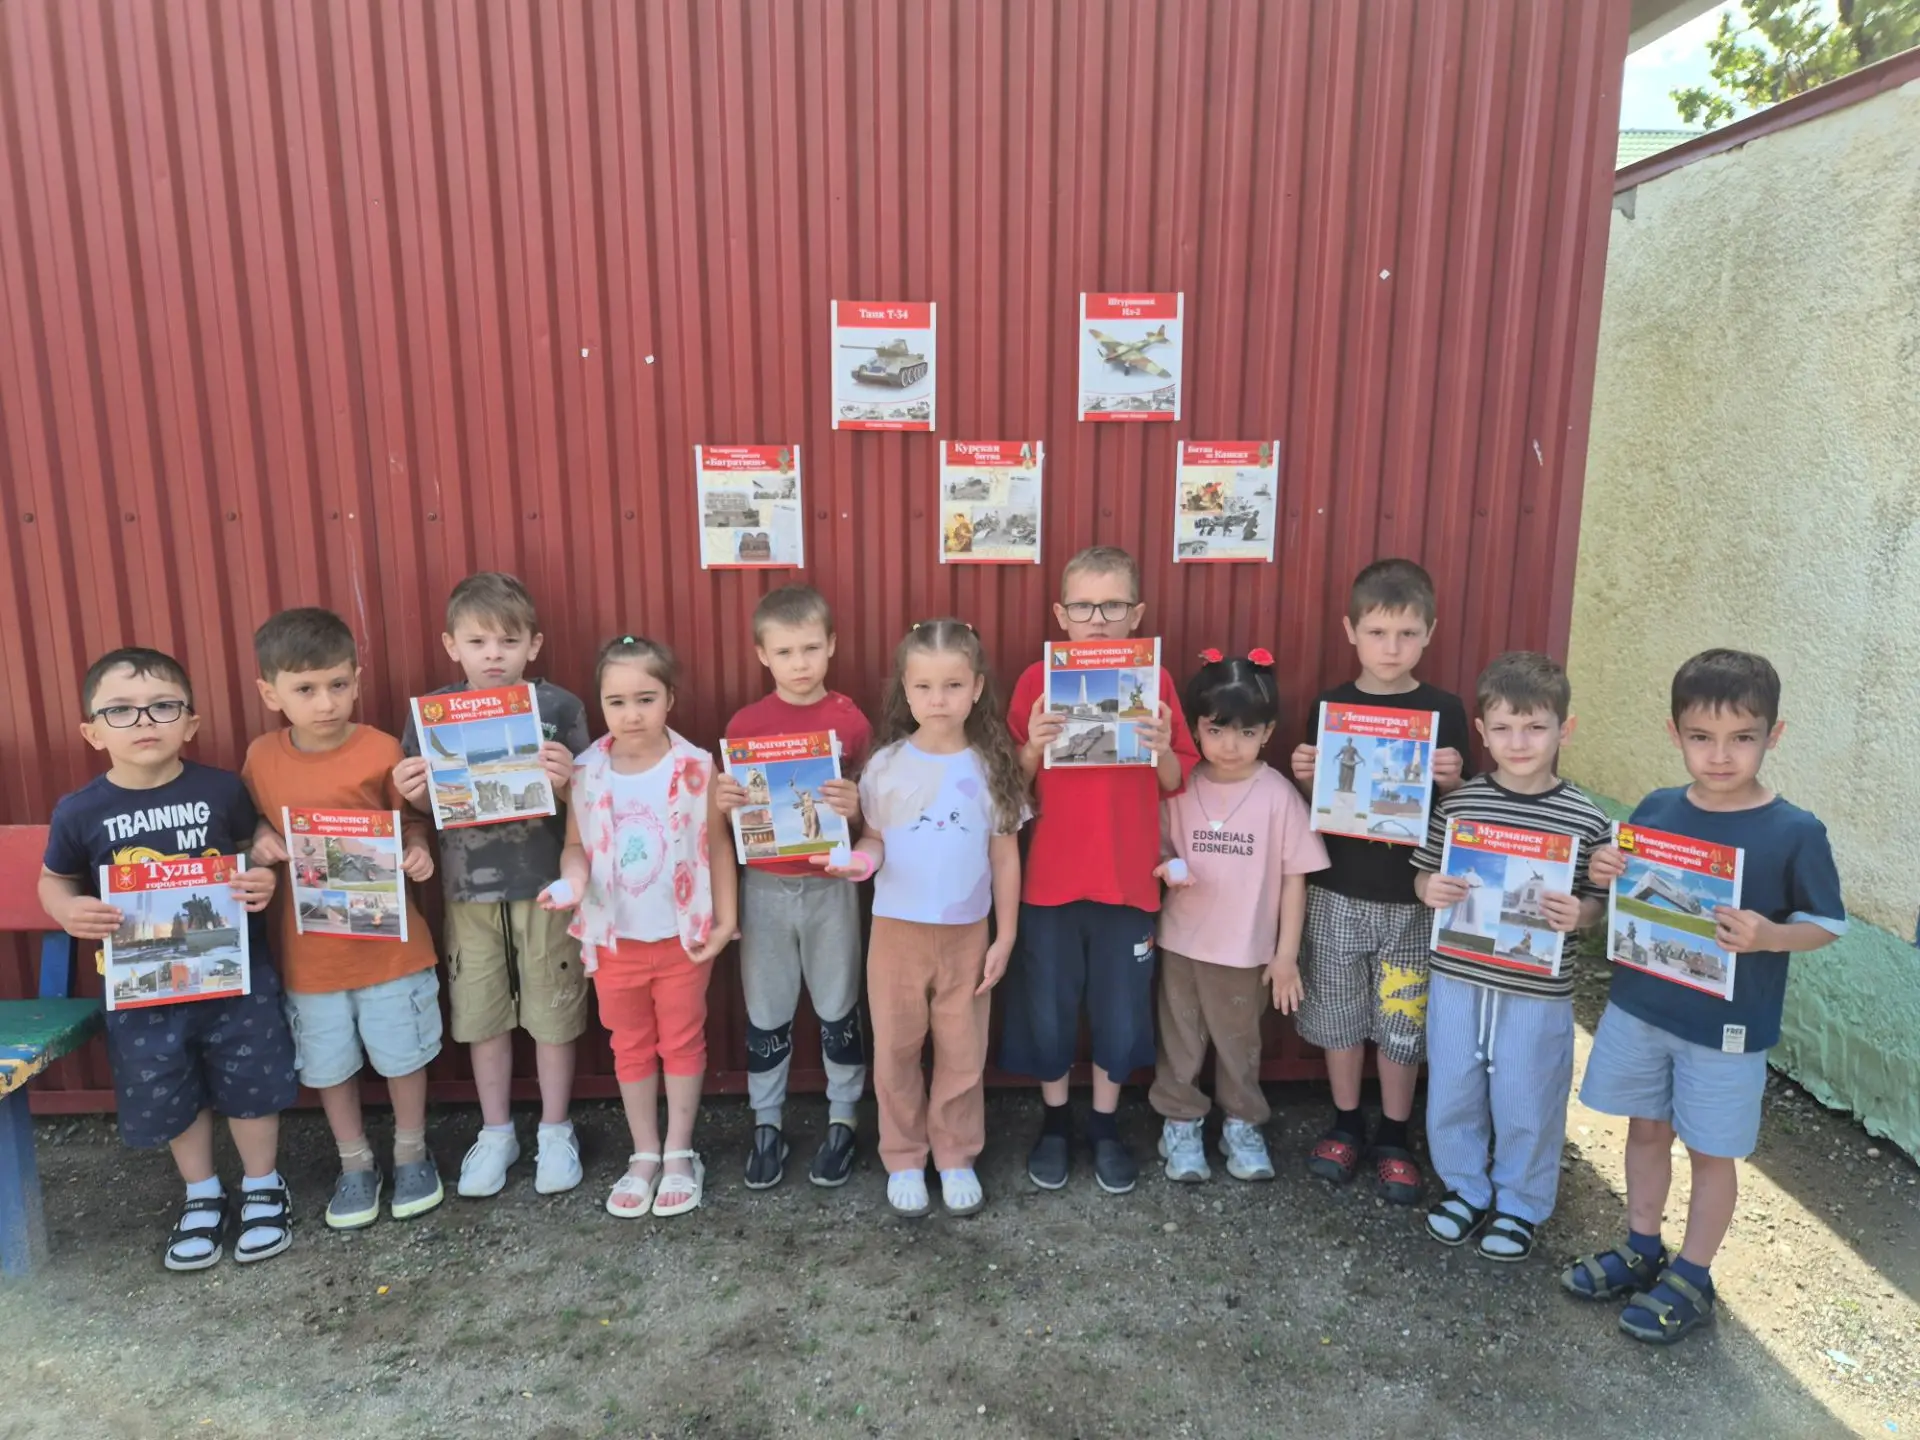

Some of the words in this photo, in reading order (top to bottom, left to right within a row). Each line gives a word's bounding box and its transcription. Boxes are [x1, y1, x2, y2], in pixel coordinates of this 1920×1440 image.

[859, 308, 885, 320] Танк
[886, 309, 909, 321] Т-34
[955, 444, 1000, 456] Курская
[449, 696, 502, 712] Керчь
[450, 707, 504, 721] город-герой
[1342, 711, 1409, 728] Ленинград
[748, 738, 809, 751] Волгоград
[102, 801, 210, 842] TRAINING
[312, 812, 370, 824] Смоленск
[176, 825, 208, 851] MY
[1192, 830, 1256, 844] EDSNEIALS
[1477, 824, 1544, 845] Мурманск
[1191, 842, 1254, 857] EDSNEIALS
[1483, 839, 1541, 854] город-герой
[143, 861, 205, 881] Тула
[145, 876, 208, 889] город-герой
